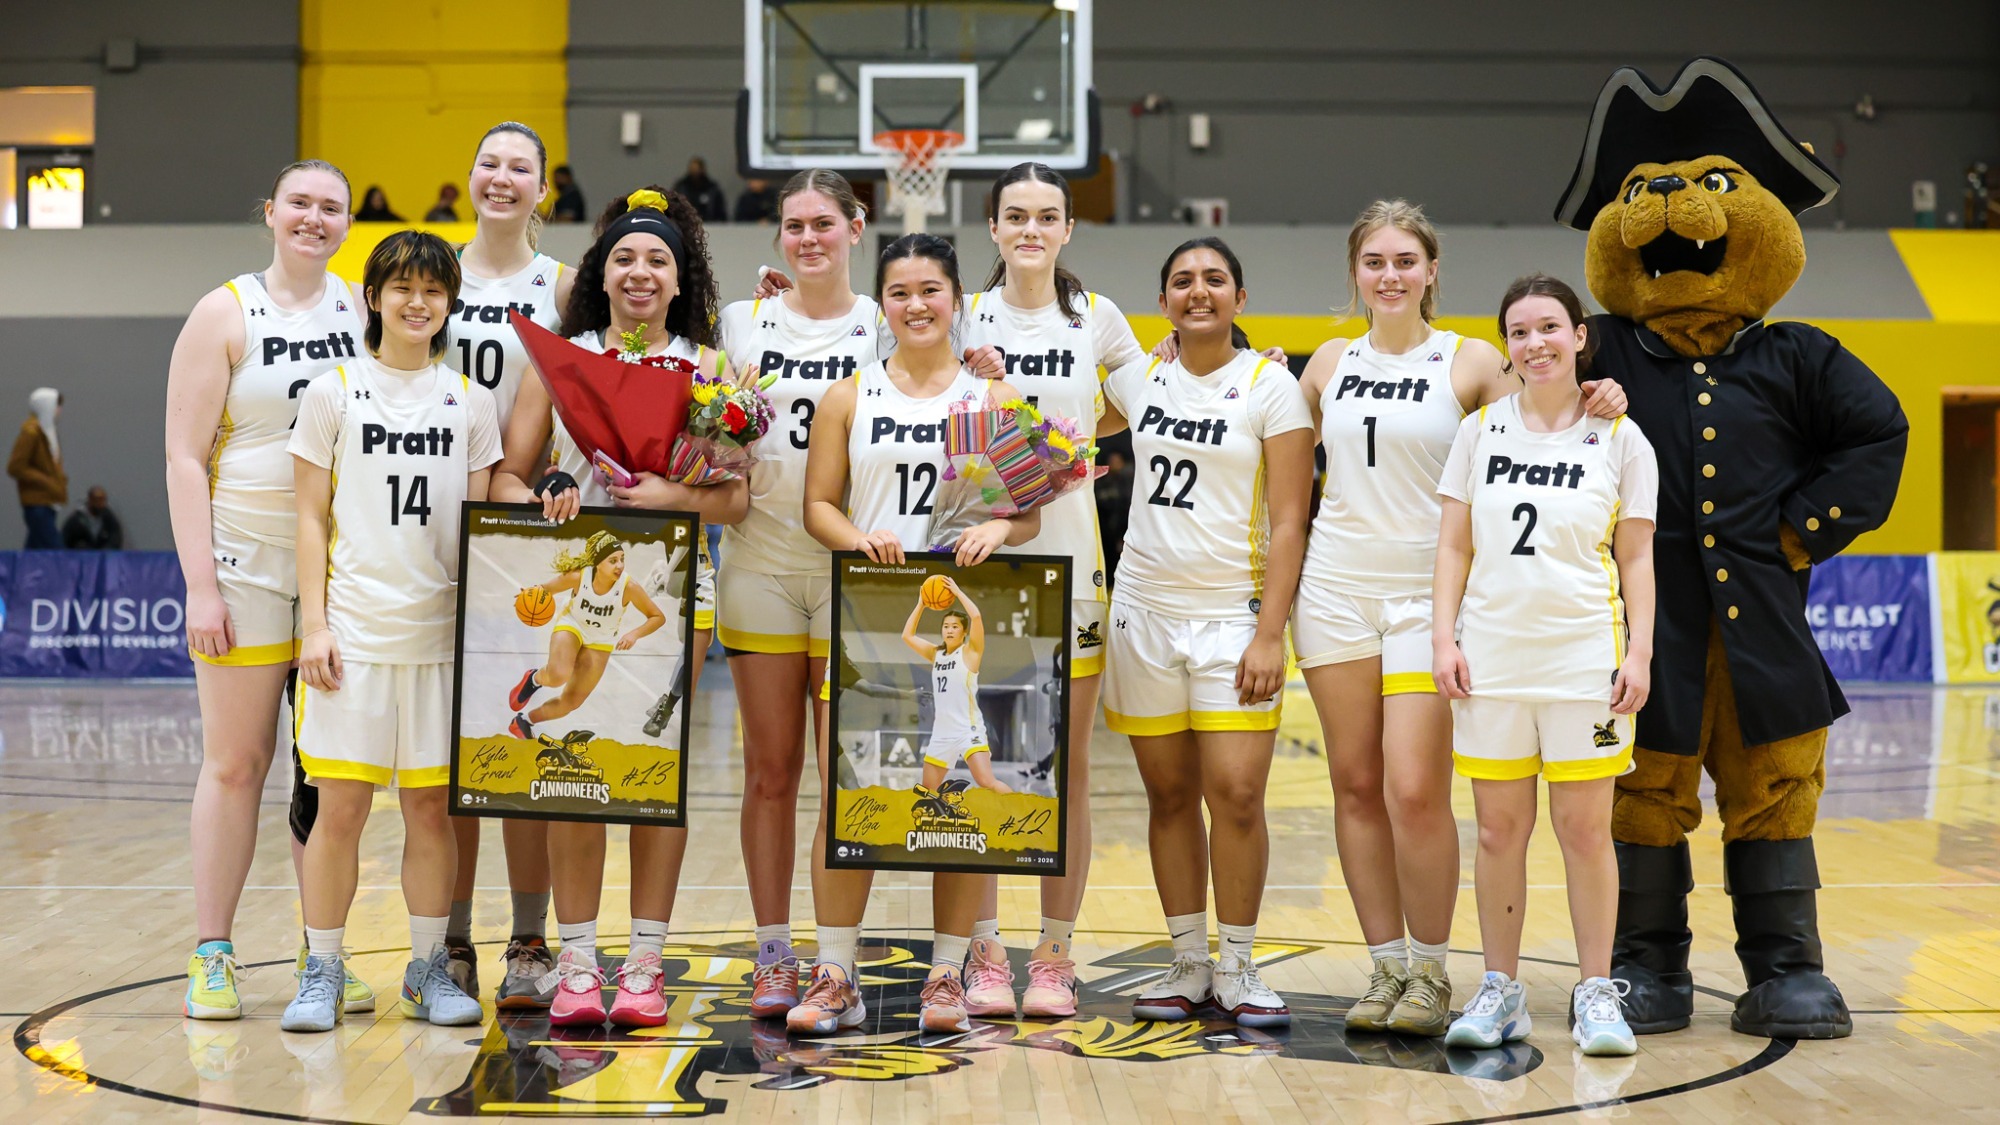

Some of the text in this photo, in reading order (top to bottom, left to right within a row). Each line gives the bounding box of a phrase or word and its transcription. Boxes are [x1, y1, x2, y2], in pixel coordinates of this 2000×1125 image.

[263, 332, 356, 365] Pratt
[994, 346, 1075, 377] ratt
[457, 338, 504, 390] 10
[759, 350, 857, 380] Pratt
[1336, 374, 1430, 403] Pratt
[790, 398, 816, 450] 3
[871, 416, 947, 445] Prat
[1137, 405, 1228, 446] Pratt
[362, 423, 454, 457] Pratt
[1362, 416, 1378, 467] 1
[1148, 455, 1198, 511] 22
[1486, 455, 1585, 489] Pratt
[386, 475, 432, 527] 14
[895, 462, 937, 516] 12
[480, 516, 499, 525] Pratt
[499, 518, 526, 527] Women's
[674, 525, 687, 540] P
[1510, 502, 1538, 556] 2
[849, 565, 927, 576] Pratt Women's Basketball
[1044, 569, 1058, 585] P
[30, 597, 184, 633] DIVISIO
[580, 598, 614, 616] Pratt
[1833, 603, 1902, 628] EAST
[1813, 629, 1874, 651] ENCE
[937, 676, 948, 693] 12
[470, 743, 509, 770] Kylie
[470, 765, 519, 784] Grant
[565, 775, 596, 783] INSTITUTE
[620, 760, 676, 787] #13
[530, 780, 610, 804] CANNONEERS
[845, 795, 889, 818] Miga
[845, 815, 881, 837] Higa
[997, 808, 1052, 836] #12
[906, 831, 986, 854] CANNONEERS
